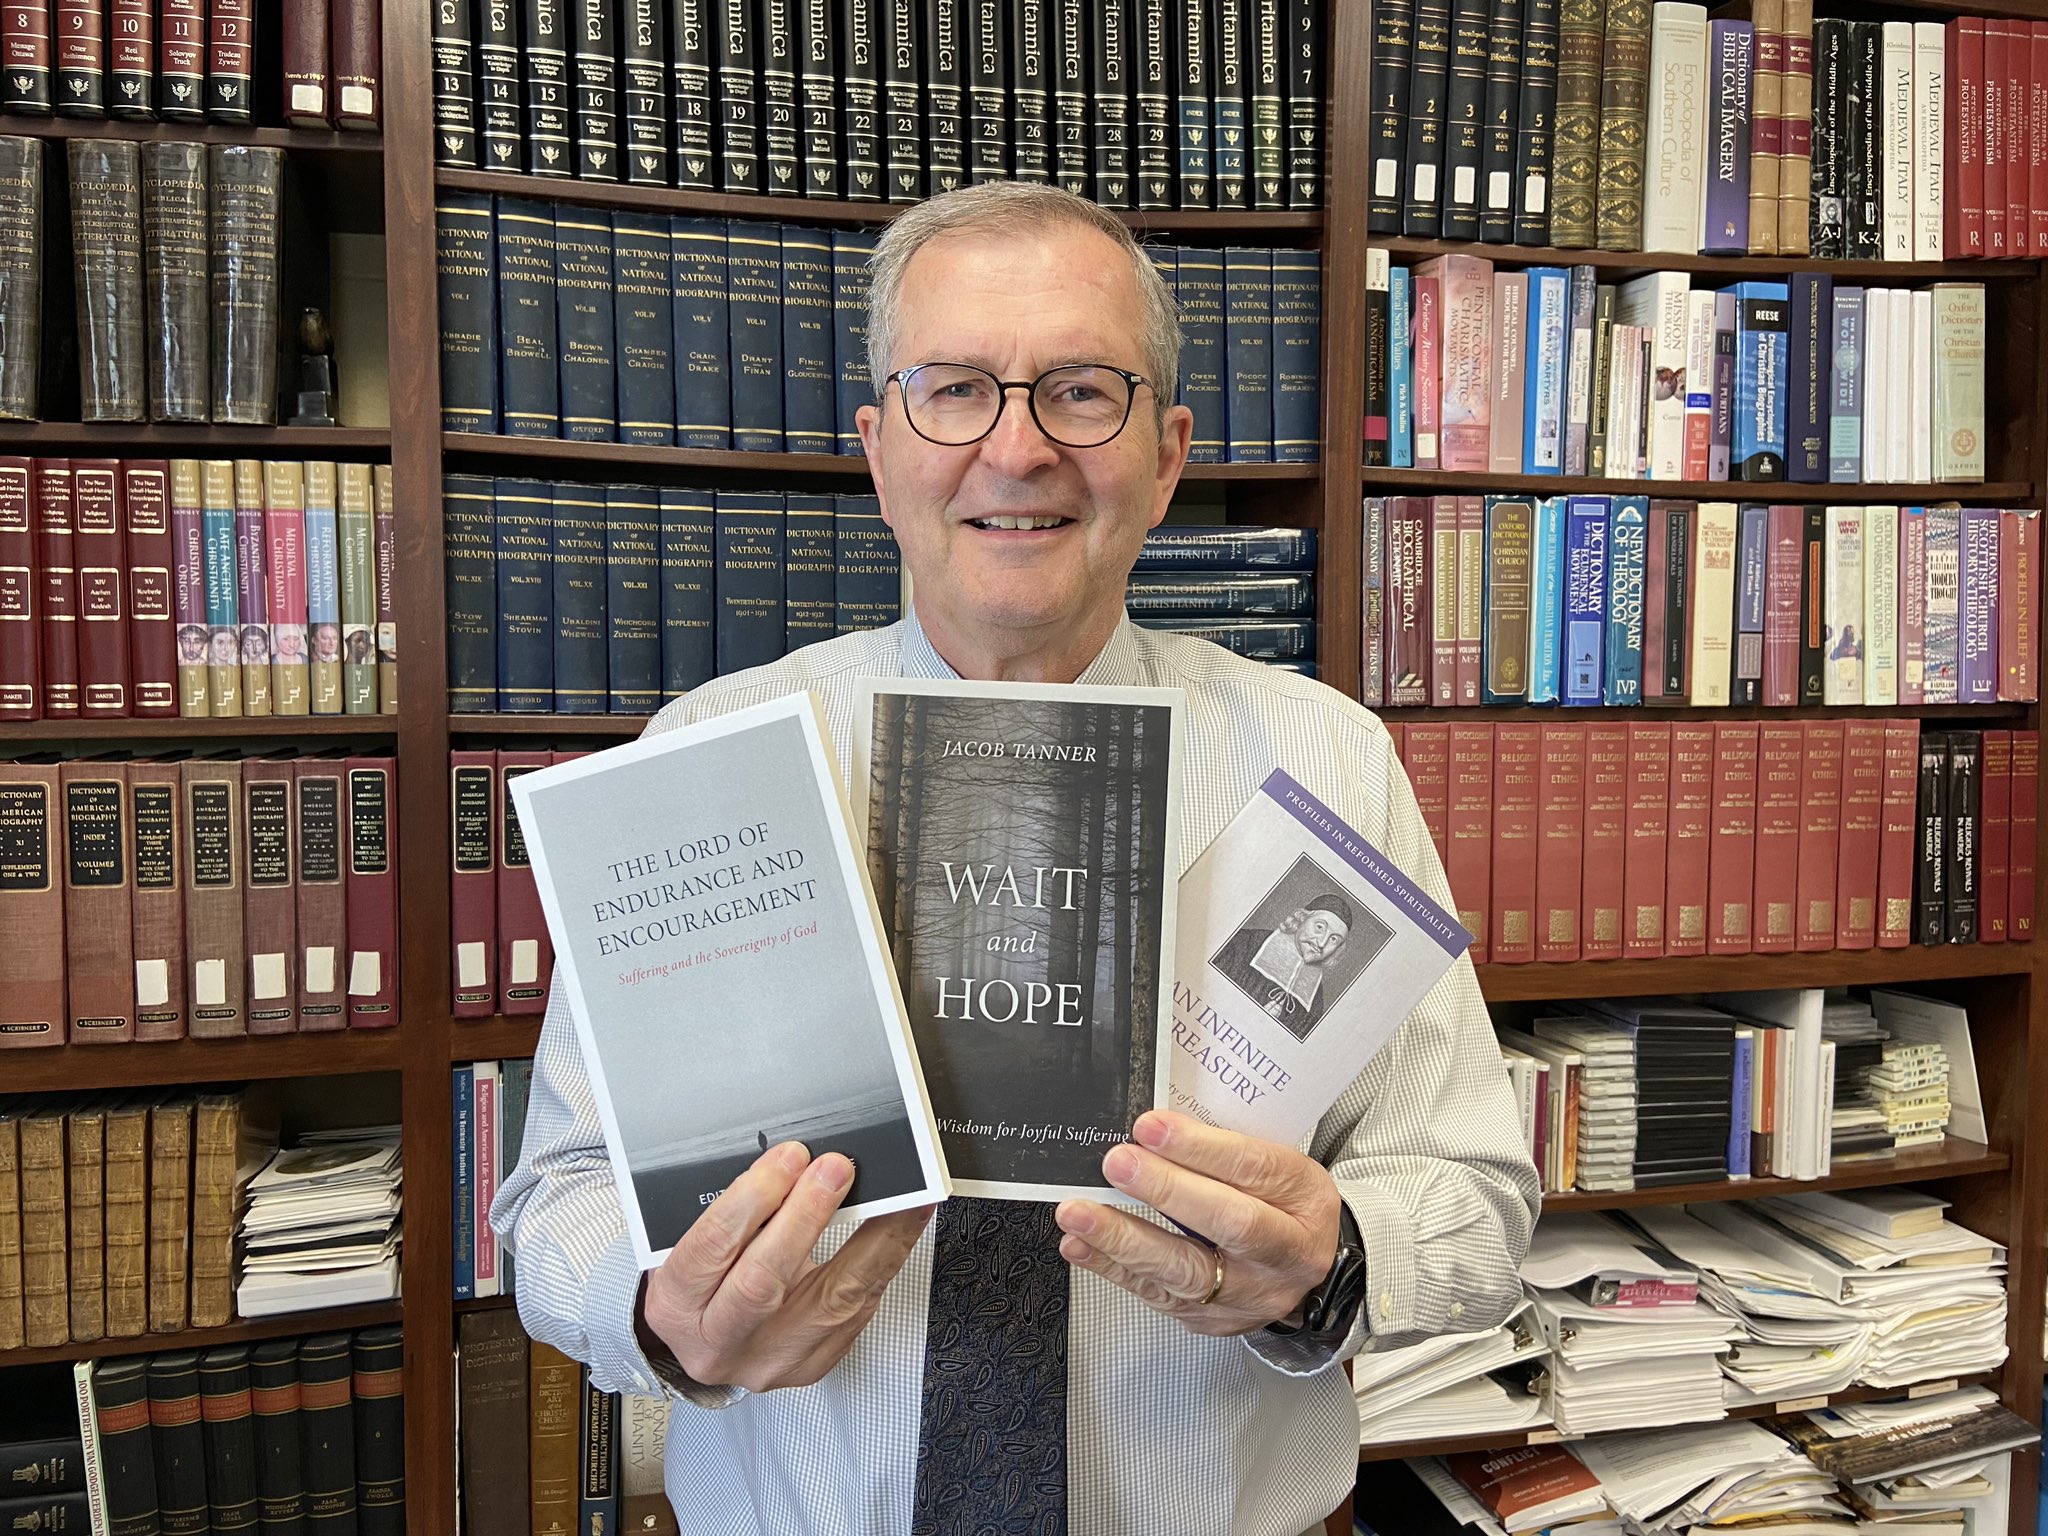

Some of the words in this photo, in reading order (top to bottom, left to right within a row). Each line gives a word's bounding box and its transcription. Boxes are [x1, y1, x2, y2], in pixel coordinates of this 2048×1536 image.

[17, 13, 28, 28] 8
[72, 16, 82, 31] 9
[122, 19, 139, 33] 10
[174, 21, 190, 36] 11
[221, 23, 237, 37] 12
[168, 49, 197, 58] Solovyov
[218, 58, 240, 66] Zywiec
[1721, 31, 1735, 104] BIBLICAL
[1736, 32, 1750, 109] Dictionary
[1829, 63, 1837, 97] Middle
[444, 77, 459, 91] 13
[640, 98, 654, 112] 17
[1387, 94, 1395, 107] 1
[1465, 104, 1474, 117] 3
[1662, 62, 1680, 138] Southern
[1680, 64, 1698, 160] Encyclopedia
[1897, 69, 1910, 155] MEDIEVAL
[773, 109, 789, 122] 20
[813, 113, 827, 126] 21
[1535, 114, 1543, 126] 5
[1736, 110, 1747, 124] of
[1829, 116, 1836, 128] of
[1961, 79, 1970, 164] PROTESTANTISM
[983, 123, 997, 136] 25
[1150, 129, 1163, 142] 29
[1719, 107, 1735, 183] IMAGERY
[1188, 158, 1204, 167] A-K
[1224, 158, 1240, 167] L-Z
[1660, 141, 1678, 197] Culture
[1828, 132, 1836, 195] Encyclopedia
[1679, 168, 1692, 186] of
[1897, 159, 1909, 203] ITALY
[1821, 227, 1842, 238] A-J
[1858, 231, 1881, 245] K-Z
[616, 248, 671, 262] DICTIONARY
[621, 268, 667, 280] NATIONAL
[617, 284, 672, 296] BIOGRAPHY
[1393, 278, 1404, 309] Biblical
[1421, 292, 1432, 332] Christian
[1546, 290, 1554, 353] CHRISTIAN
[1663, 290, 1672, 350] THEOLOGY
[1672, 291, 1683, 351] MISSION
[1755, 310, 1779, 321] REESE
[1941, 315, 1984, 326] Dictionary
[1948, 303, 1978, 314] Oxford
[1393, 311, 1402, 340] Social
[1471, 287, 1484, 390] PENTECOSTAL
[1757, 333, 1767, 341] of
[569, 342, 603, 352] BROWN
[1369, 308, 1379, 401] EVANGELICALISM
[1393, 342, 1401, 369] Values
[1421, 335, 1431, 372] Ministry
[1457, 297, 1470, 403] CHARISMATIC
[1944, 338, 1981, 347] Christian
[563, 355, 610, 365] CHALONER
[741, 355, 774, 364] DRANT
[743, 366, 771, 375] FINAN
[798, 358, 825, 367] FINCH
[1757, 343, 1766, 386] Christian
[1544, 356, 1552, 405] MARTYRS
[1420, 376, 1430, 426] Sourcebook
[1718, 388, 1726, 434] PURITANS
[1756, 388, 1767, 443] Biographies
[219, 527, 230, 549] LATE
[1585, 522, 1590, 531] OF
[1614, 526, 1629, 546] OF
[189, 528, 201, 586] CHRISTIAN
[286, 528, 296, 578] MEDIEVAL
[1414, 520, 1423, 586] CAMBRIDGE
[1628, 527, 1644, 563] NEW
[1968, 519, 1978, 576] HISTORY
[1979, 520, 1989, 592] SCOTTISH
[725, 561, 778, 570] BIOGRAPHY
[1497, 558, 1526, 566] CHURCH
[1589, 522, 1605, 614] DICTIONARY
[1988, 520, 1998, 598] DICTIONARY
[177, 564, 189, 611] ORIGINS
[220, 551, 232, 601] ANCIENT
[1402, 520, 1414, 632] BIOGRAPHICAL
[1570, 548, 1580, 614] MOVEMENT
[1580, 549, 1590, 614] ECUMENICAL
[1612, 549, 1627, 626] THEOLOGY
[1930, 573, 1957, 585] MODERN
[1968, 577, 1976, 589] &
[1132, 596, 1217, 610] CHRISTIANITY
[1930, 588, 1957, 599] THOUGHT
[1991, 598, 1996, 607] of
[503, 612, 549, 622] SHEARMAN
[1627, 568, 1643, 651] DICTIONARY
[508, 626, 543, 634] STOVIN
[1966, 591, 1978, 660] THEOLOGY
[1978, 596, 1988, 652] CHURCH
[1616, 680, 1637, 694] IVP
[941, 738, 1005, 759] JACOB
[1012, 741, 1096, 763] TANNER
[69, 787, 117, 796] DICTIONARY
[71, 804, 118, 812] AMERICAN
[71, 812, 118, 821] BIOGRAPHY
[1926, 818, 1933, 827] IN
[76, 860, 115, 869] VOLUMES
[608, 853, 660, 883] THE
[665, 834, 731, 868] LORD
[738, 822, 769, 847] OF
[1284, 789, 1333, 833] PROFILES
[1332, 828, 1346, 844] IN
[1343, 838, 1395, 888] REFORMED
[1393, 883, 1456, 941] SPIRITUALITY
[592, 865, 745, 922] ENDURANCE
[752, 849, 804, 880] AND
[939, 861, 1088, 910] WAIT
[597, 879, 817, 956] ENCOURAGEMENT
[618, 965, 668, 986] Suffering
[671, 954, 692, 972] and
[695, 952, 712, 965] the
[714, 932, 776, 959] Sovereignty
[780, 929, 792, 945] of
[793, 921, 818, 939] God
[986, 929, 1037, 954] and
[933, 975, 1085, 1028] HOPE
[1172, 1016, 1265, 1106] REASURY
[1195, 1005, 1292, 1092] INFINITE
[1177, 1092, 1188, 1105] of
[936, 1117, 991, 1138] Wisdom
[993, 1119, 1019, 1140] for
[1019, 1123, 1062, 1143] Joyful
[1064, 1123, 1130, 1146] Suffering
[78, 1380, 88, 1394] 100
[79, 1397, 95, 1449] PORTRETTEN
[591, 1391, 600, 1442] REFORMED
[86, 1450, 96, 1465] VAN
[590, 1444, 598, 1492] CHURCHES
[1481, 1446, 1541, 1474] CONFLICT
[88, 1467, 103, 1530] GODGELEERDEN
